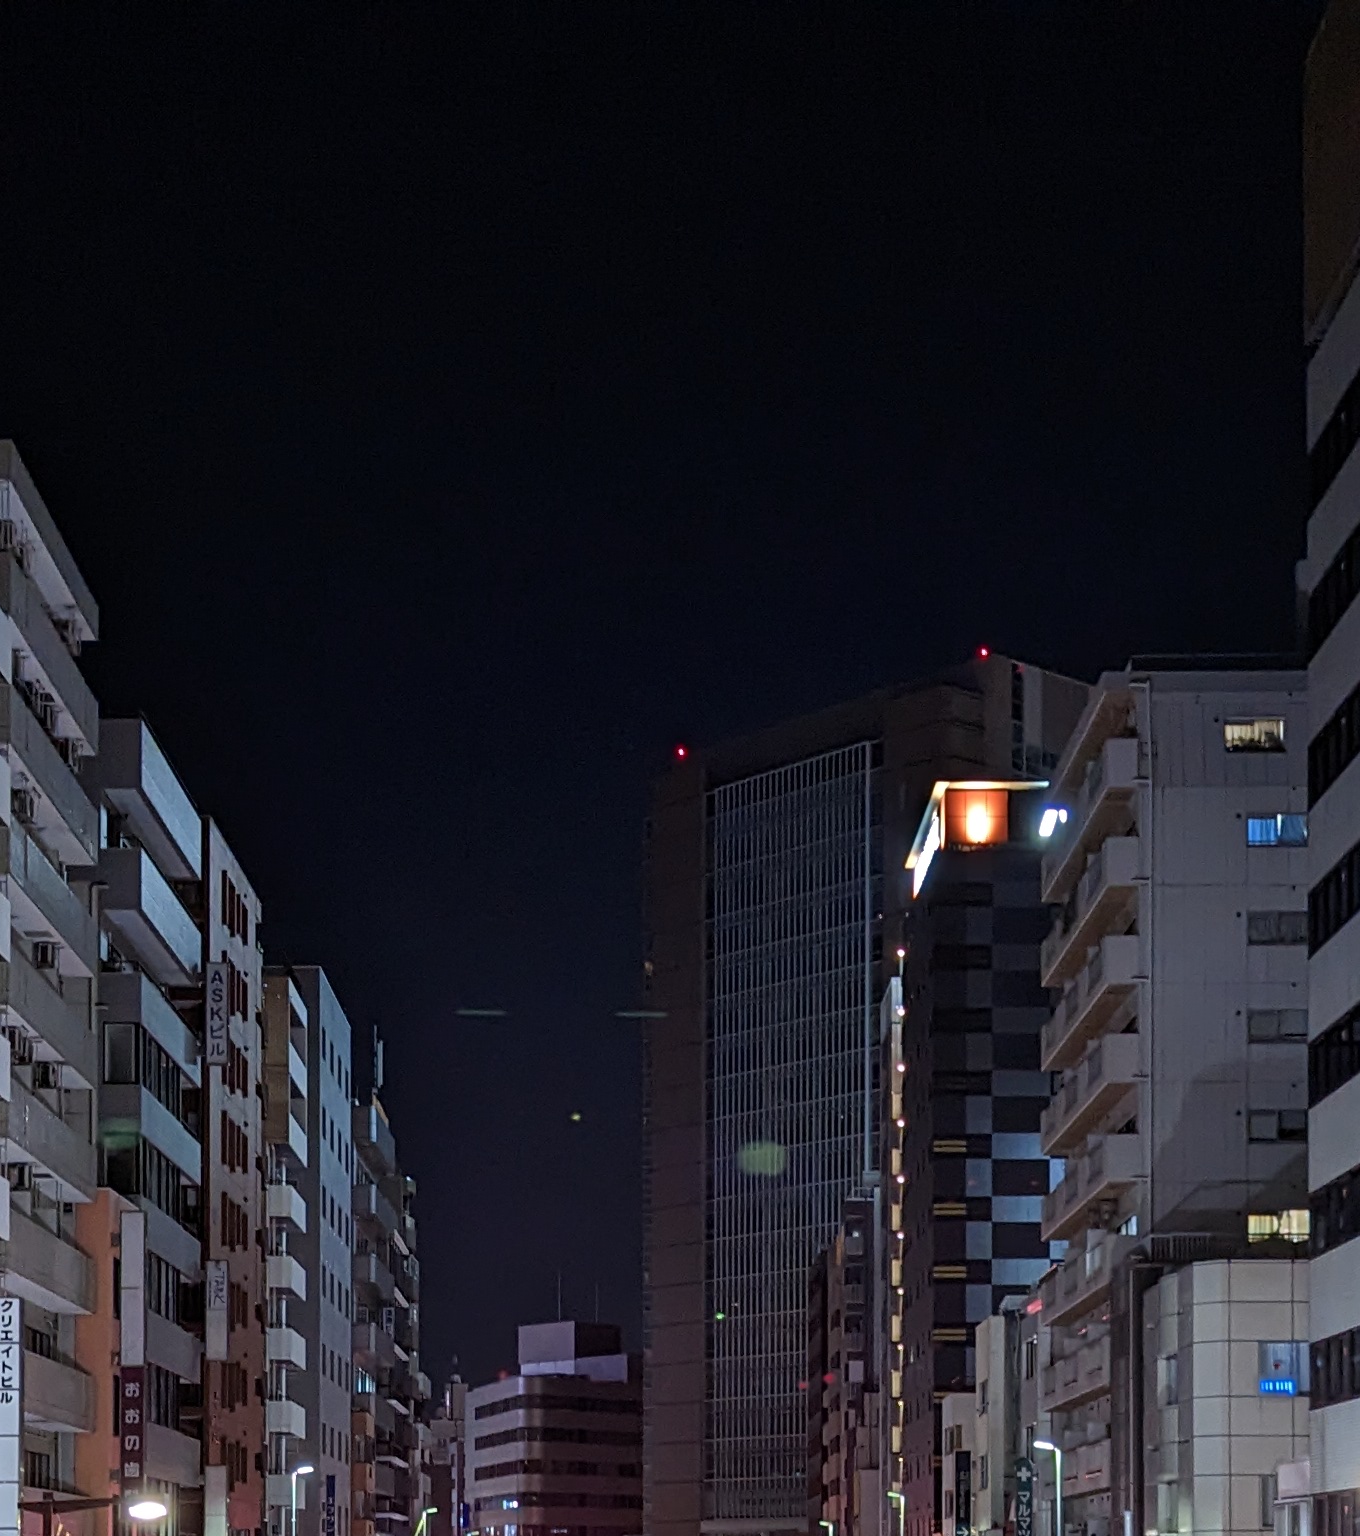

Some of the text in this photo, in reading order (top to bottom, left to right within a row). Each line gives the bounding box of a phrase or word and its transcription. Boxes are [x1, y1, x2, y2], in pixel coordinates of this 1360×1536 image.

[210, 970, 225, 1057] ASKビル
[0, 1300, 14, 1405] クリエイトビル
